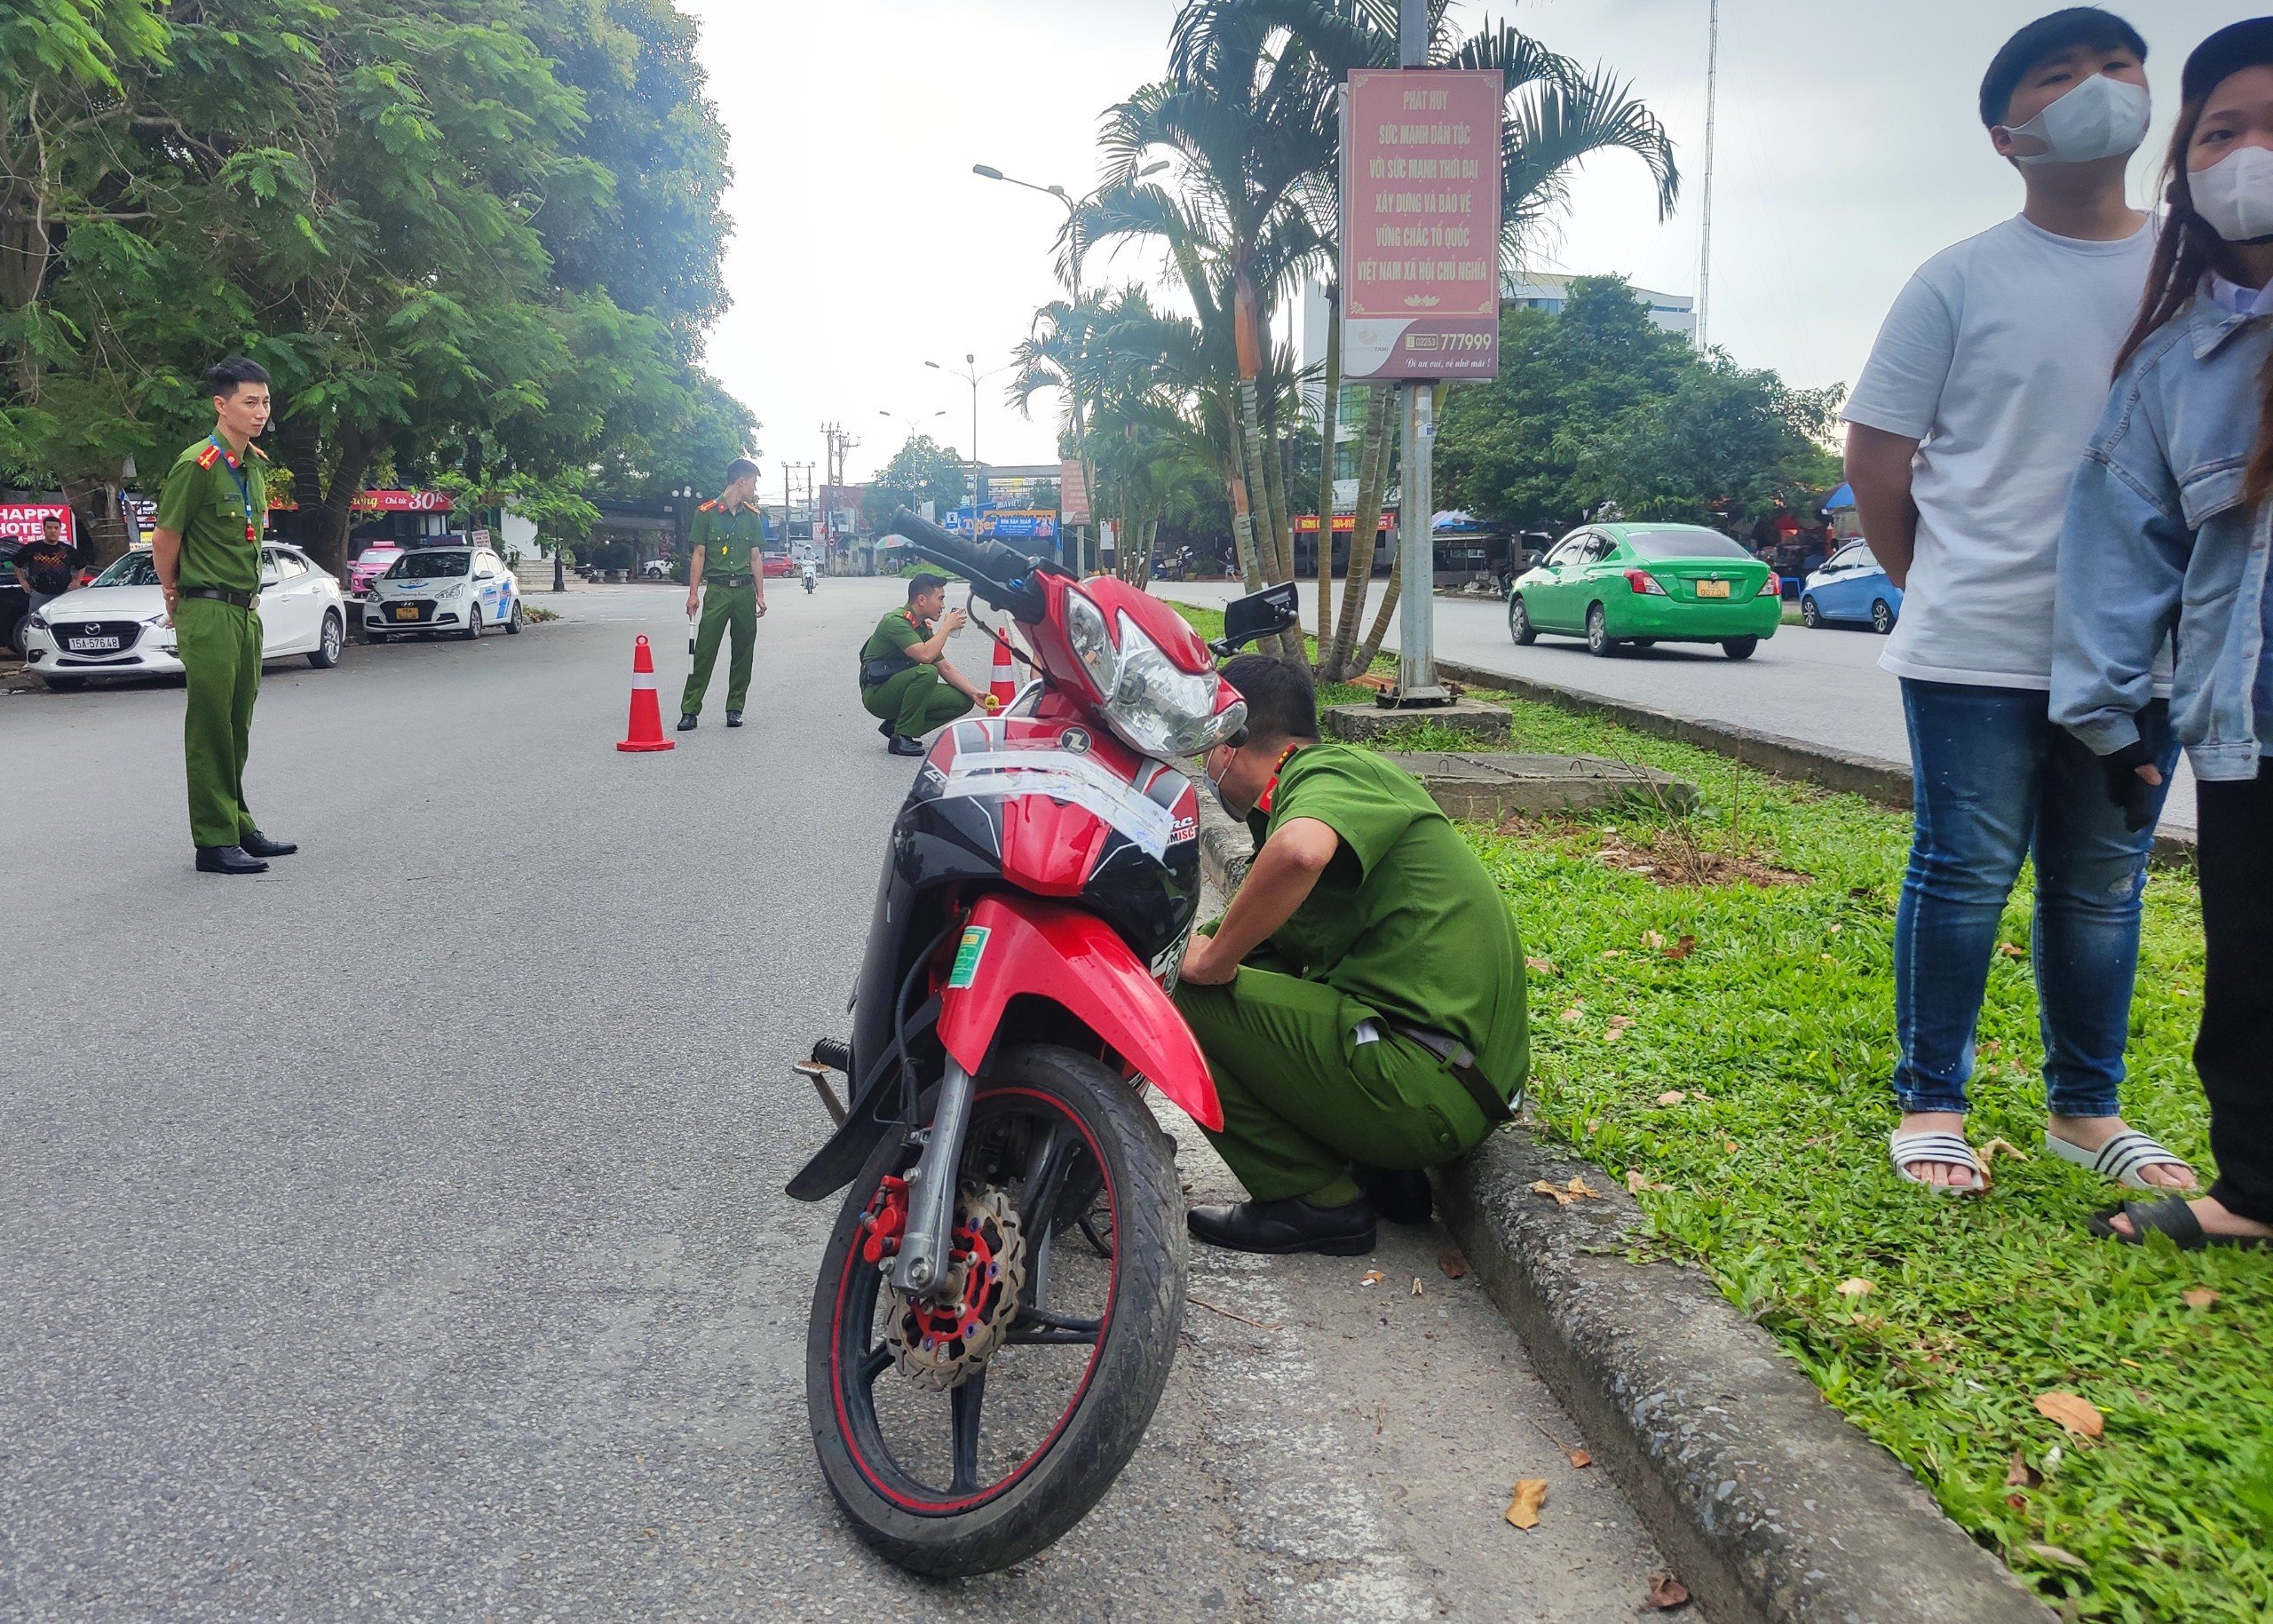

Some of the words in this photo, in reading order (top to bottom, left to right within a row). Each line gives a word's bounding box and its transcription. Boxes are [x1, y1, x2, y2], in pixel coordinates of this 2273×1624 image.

[1403, 86, 1427, 110] PHÁT
[1430, 91, 1448, 110] HUY
[1379, 121, 1398, 145] SỨC
[1400, 124, 1429, 148] MẠNH
[1430, 121, 1451, 145] DÂN
[1453, 121, 1471, 149] TỘC
[1369, 155, 1385, 178] VỚI
[1388, 155, 1406, 178] SỨC
[1408, 159, 1437, 183] MẠNH
[1439, 155, 1461, 178] THỜI
[1462, 159, 1478, 183] ĐẠI
[1375, 189, 1394, 213] XÂY
[1395, 192, 1421, 218] DỰNG
[1424, 189, 1436, 213] VÀ
[1438, 186, 1457, 213] BẢO
[1460, 189, 1471, 218] VỆ
[1376, 223, 1400, 247] VỮNG
[1404, 220, 1429, 247] CHẮC
[1430, 220, 1443, 247] TỔ
[1445, 221, 1469, 249] QUỐC
[1358, 257, 1377, 285] VIỆT
[1380, 261, 1401, 281] NAM
[1404, 257, 1416, 281] XÃ
[1419, 257, 1434, 285] HỘI
[1437, 255, 1455, 281] CHỦ
[1458, 257, 1486, 281] NGHĨA
[1440, 333, 1492, 351] 777999
[0, 509, 63, 520] HAPPY
[71, 638, 118, 649] 15A-576.48
